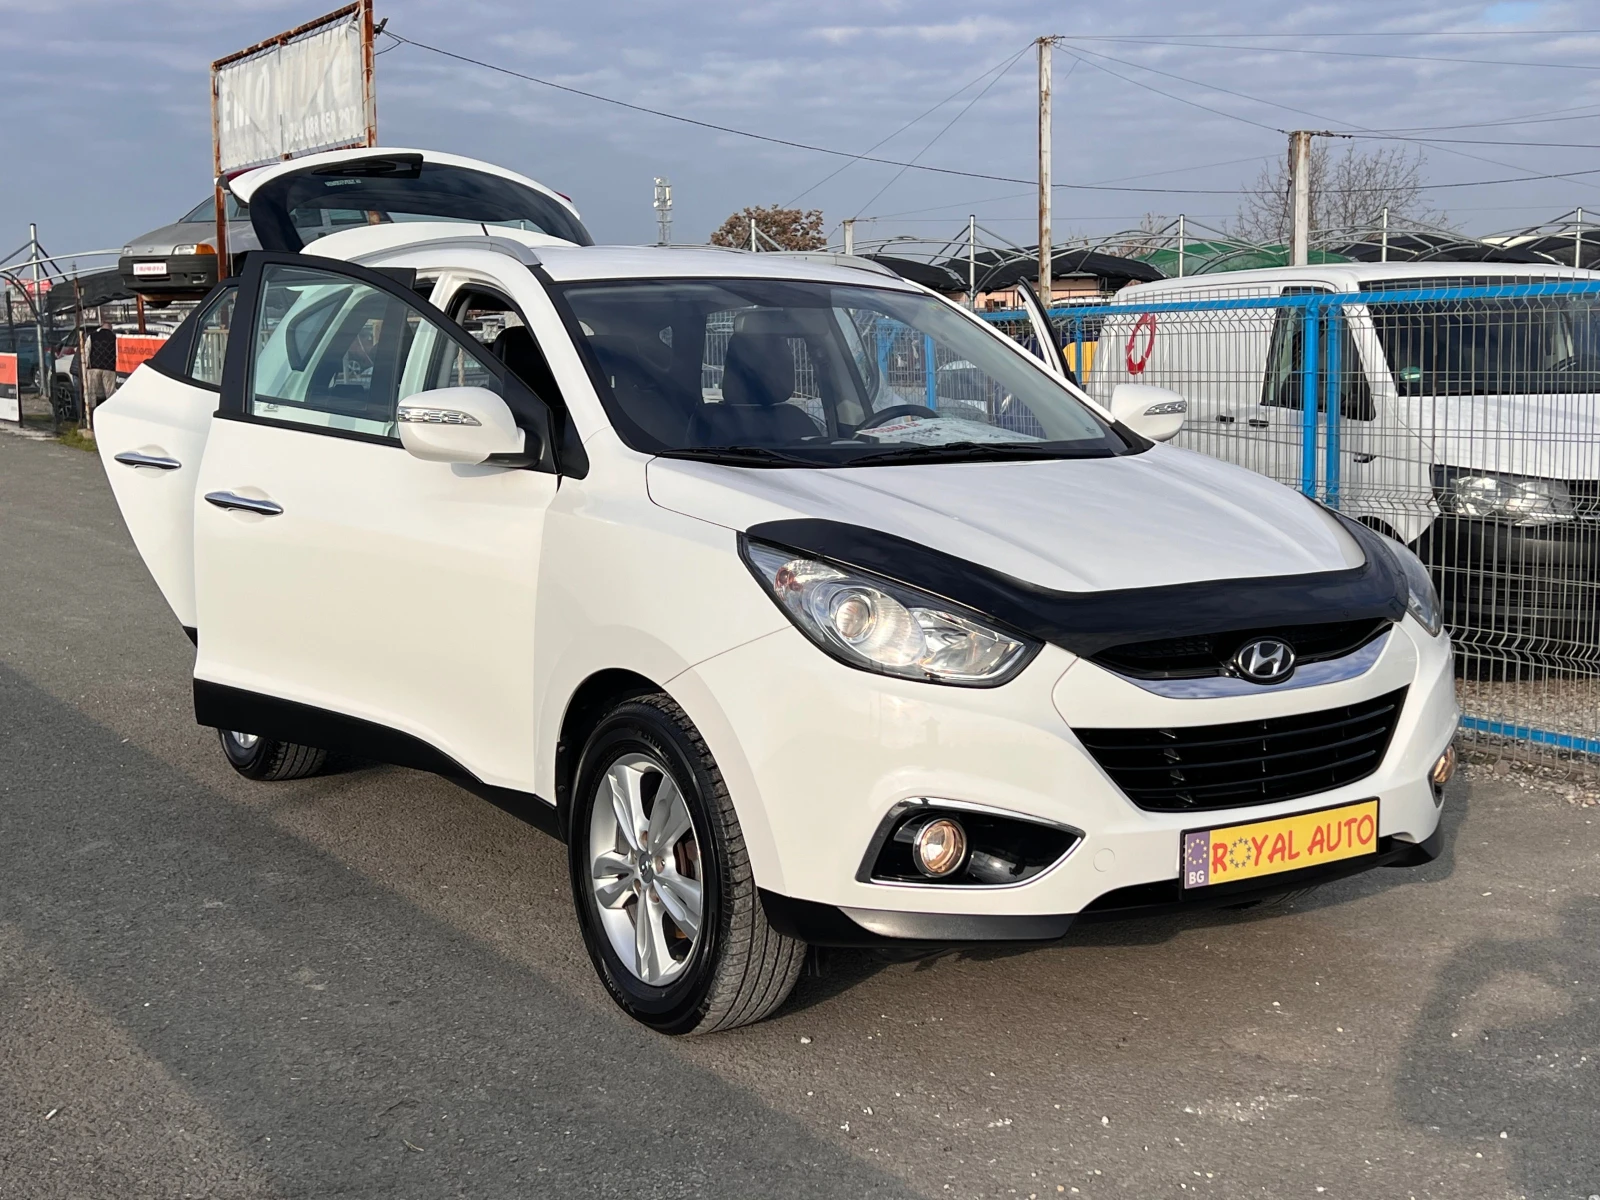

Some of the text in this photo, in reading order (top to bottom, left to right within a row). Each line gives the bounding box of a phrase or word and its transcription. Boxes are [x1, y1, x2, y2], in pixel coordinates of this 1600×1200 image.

[1211, 814, 1374, 875] ROYAL AUTO
[1189, 869, 1205, 885] BG
